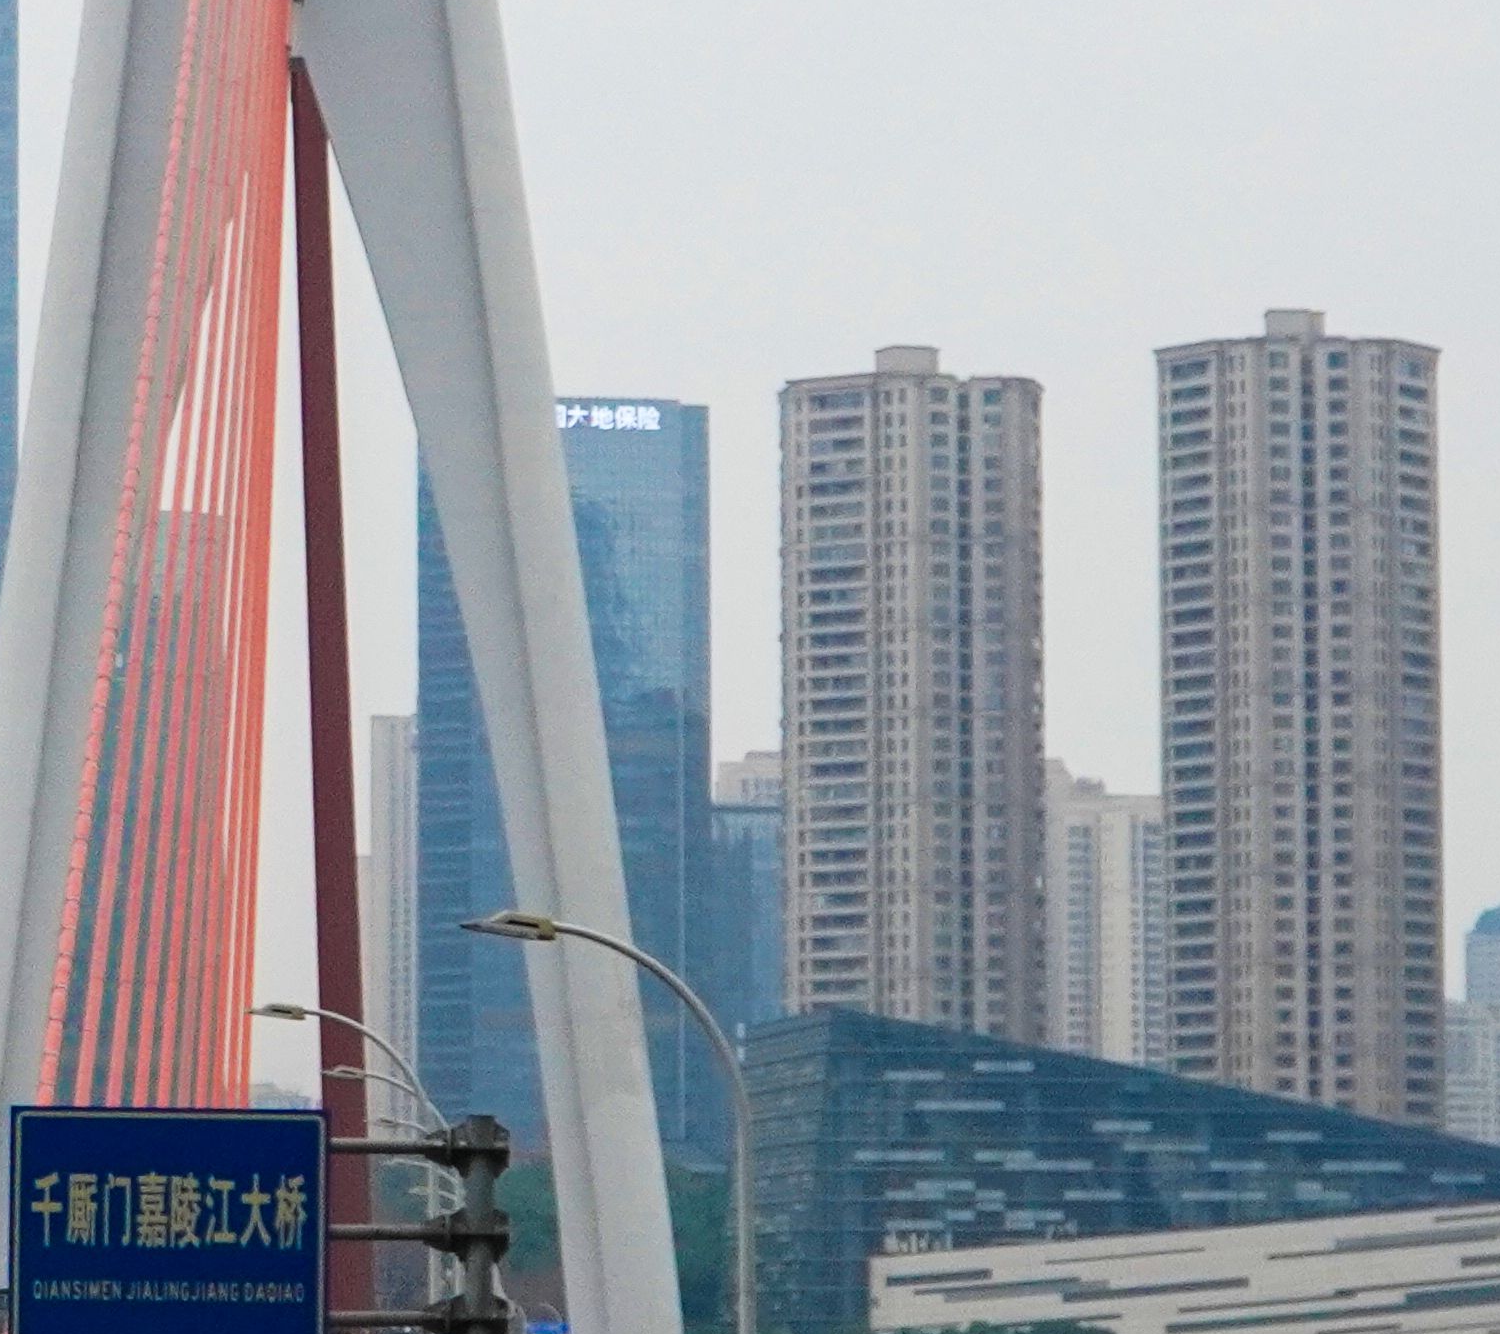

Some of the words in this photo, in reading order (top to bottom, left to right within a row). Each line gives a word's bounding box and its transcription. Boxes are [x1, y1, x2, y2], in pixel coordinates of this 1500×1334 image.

[31, 1171, 308, 1249] 千厮门嘉陵江大桥
[33, 1280, 122, 1300] QIANSIMEN
[244, 1282, 305, 1303] DAQIAO
